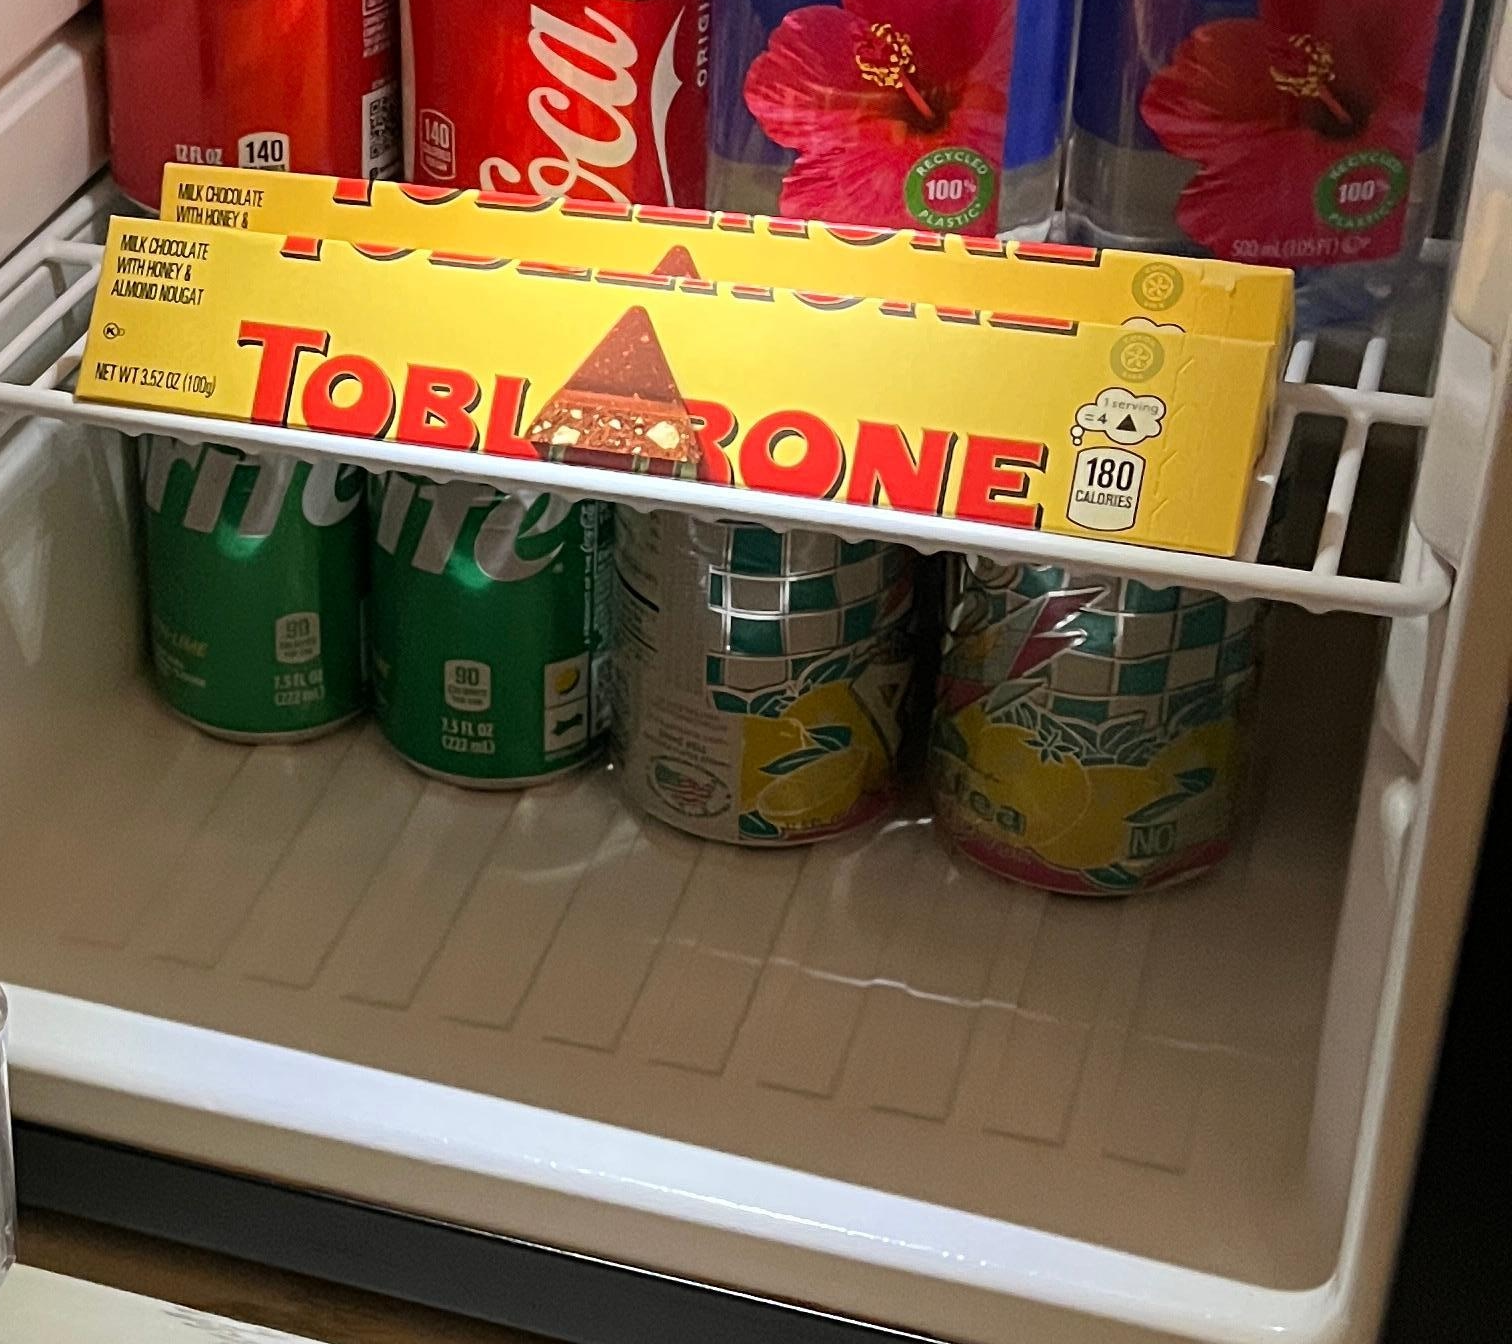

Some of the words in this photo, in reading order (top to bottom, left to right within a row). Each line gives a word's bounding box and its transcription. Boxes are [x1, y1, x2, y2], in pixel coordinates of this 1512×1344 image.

[425, 119, 450, 149] 140
[245, 139, 284, 163] 140
[916, 151, 988, 176] RECYCLED
[178, 183, 204, 202] MILK
[205, 186, 265, 208] CHOCOLATE
[925, 178, 977, 201] 100%
[176, 205, 203, 224] WITH
[205, 209, 240, 227] HONEY
[241, 212, 249, 229] &
[120, 234, 148, 253] MILK
[149, 237, 210, 261] CHOCOLATE
[116, 256, 145, 274] WITH
[146, 260, 183, 280] HONEY
[184, 264, 192, 282] &
[110, 279, 158, 301] ALMOND
[159, 284, 205, 306] NOUGAT
[94, 362, 117, 382] NET
[119, 365, 141, 386] WT
[140, 367, 165, 388] 3.52
[166, 371, 182, 390] OZ
[182, 373, 217, 398] (100g)
[1096, 412, 1108, 425] 4
[1110, 400, 1159, 417] serving
[238, 319, 1049, 530] TOBLRONE
[1086, 457, 1135, 492] 180
[1075, 489, 1133, 509] CALORIES
[455, 666, 480, 687] 90
[1131, 824, 1175, 856] NO
